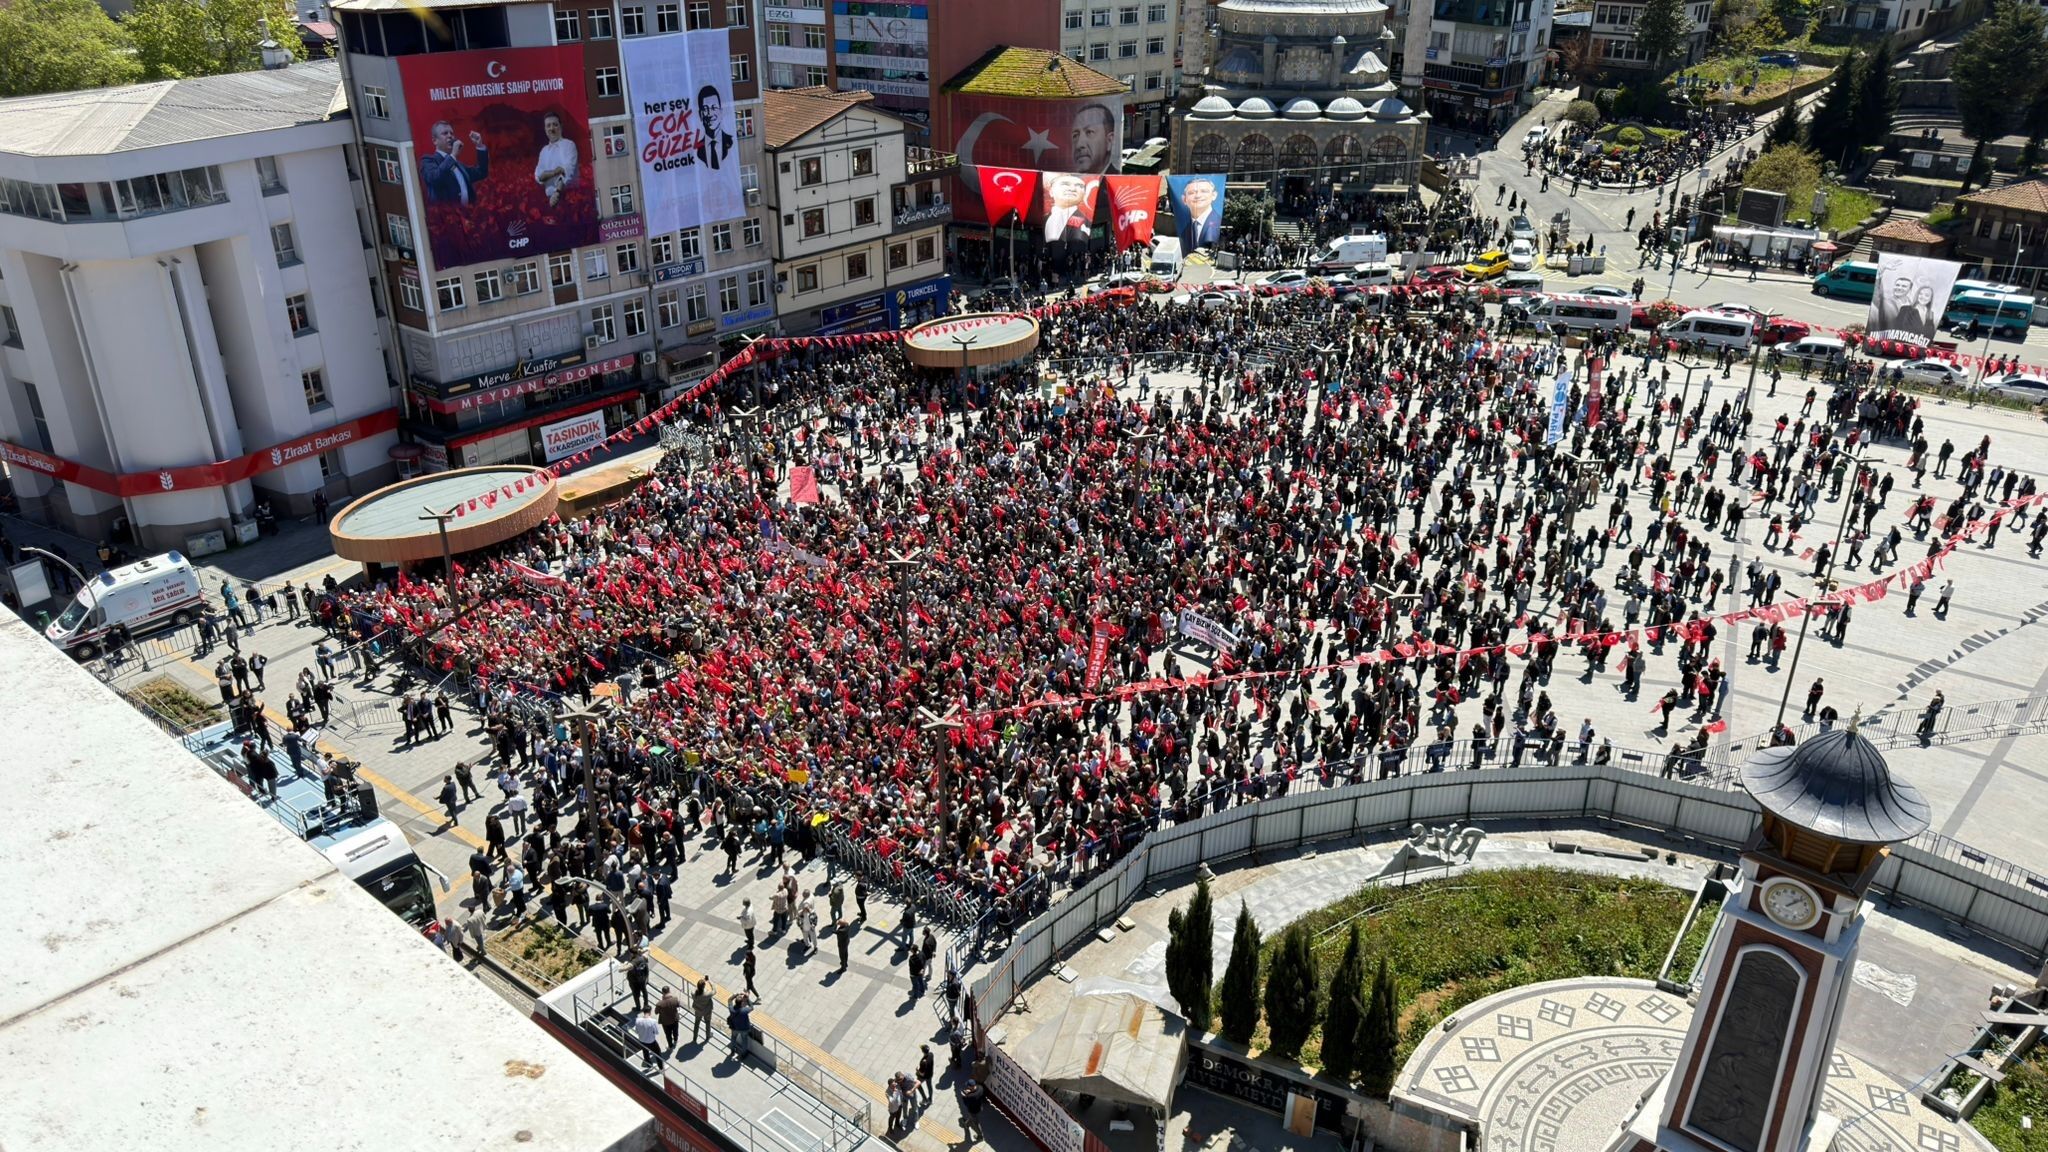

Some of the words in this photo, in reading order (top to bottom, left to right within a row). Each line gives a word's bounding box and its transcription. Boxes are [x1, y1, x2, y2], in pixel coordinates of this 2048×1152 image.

[429, 87, 460, 101] MİLLET
[462, 82, 505, 98] İRADESİNE
[506, 80, 531, 94] SAHİP
[532, 78, 564, 94] ÇIKIYOR
[644, 101, 667, 115] her
[669, 98, 690, 112] şey
[648, 109, 692, 139] ÇOK
[642, 128, 705, 163] GÜZEL
[654, 153, 695, 172] olacak
[601, 216, 640, 231] GÜZELLİK
[1118, 209, 1148, 231] CHP
[509, 237, 530, 249] CHP
[605, 228, 639, 240] SALONU
[907, 284, 938, 300] TURKCELL
[1869, 329, 1931, 348] UNUTMAYACAĞIZ
[478, 371, 511, 388] Merve
[523, 359, 558, 377] Kuaför
[461, 381, 537, 409] MEYDAN
[1553, 382, 1566, 411] SOL
[546, 420, 600, 446] TAŞINDIK
[283, 442, 313, 460] Ziraat
[315, 430, 352, 449] Bankası
[1018, 1076, 1069, 1133] BELEDİYESİ
